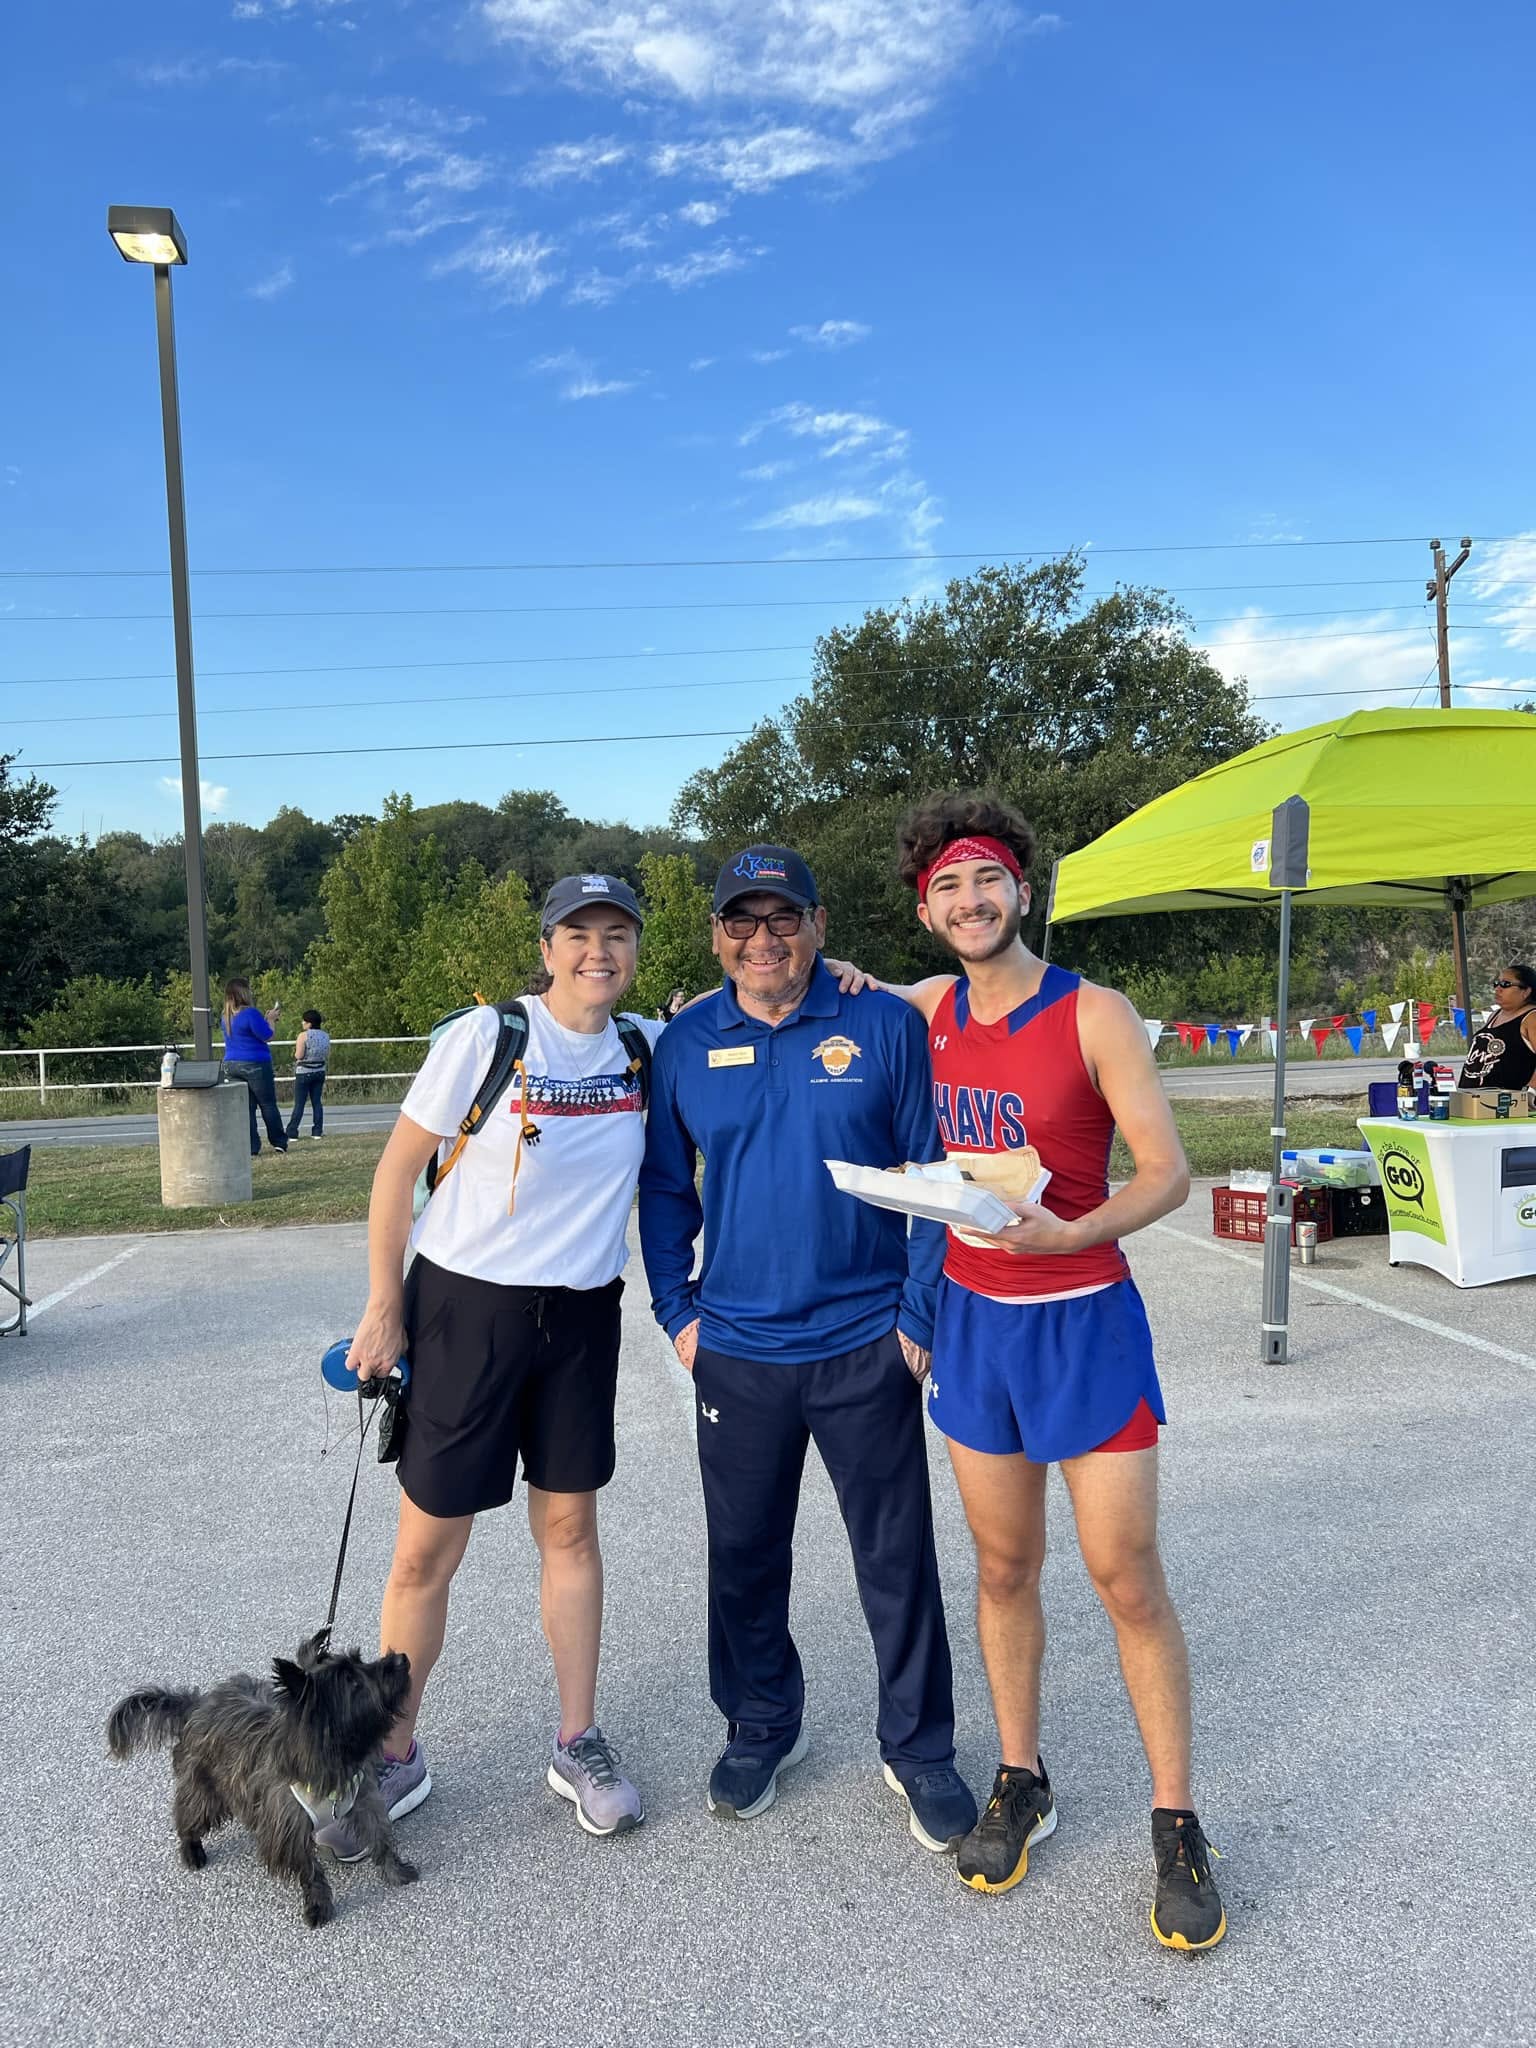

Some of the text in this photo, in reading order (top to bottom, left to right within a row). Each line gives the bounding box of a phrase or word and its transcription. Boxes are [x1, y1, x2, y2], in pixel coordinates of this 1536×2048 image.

[933, 1081, 1027, 1151] HAYS
[1386, 1166, 1419, 1190] GO!
[1520, 1207, 1536, 1220] G
